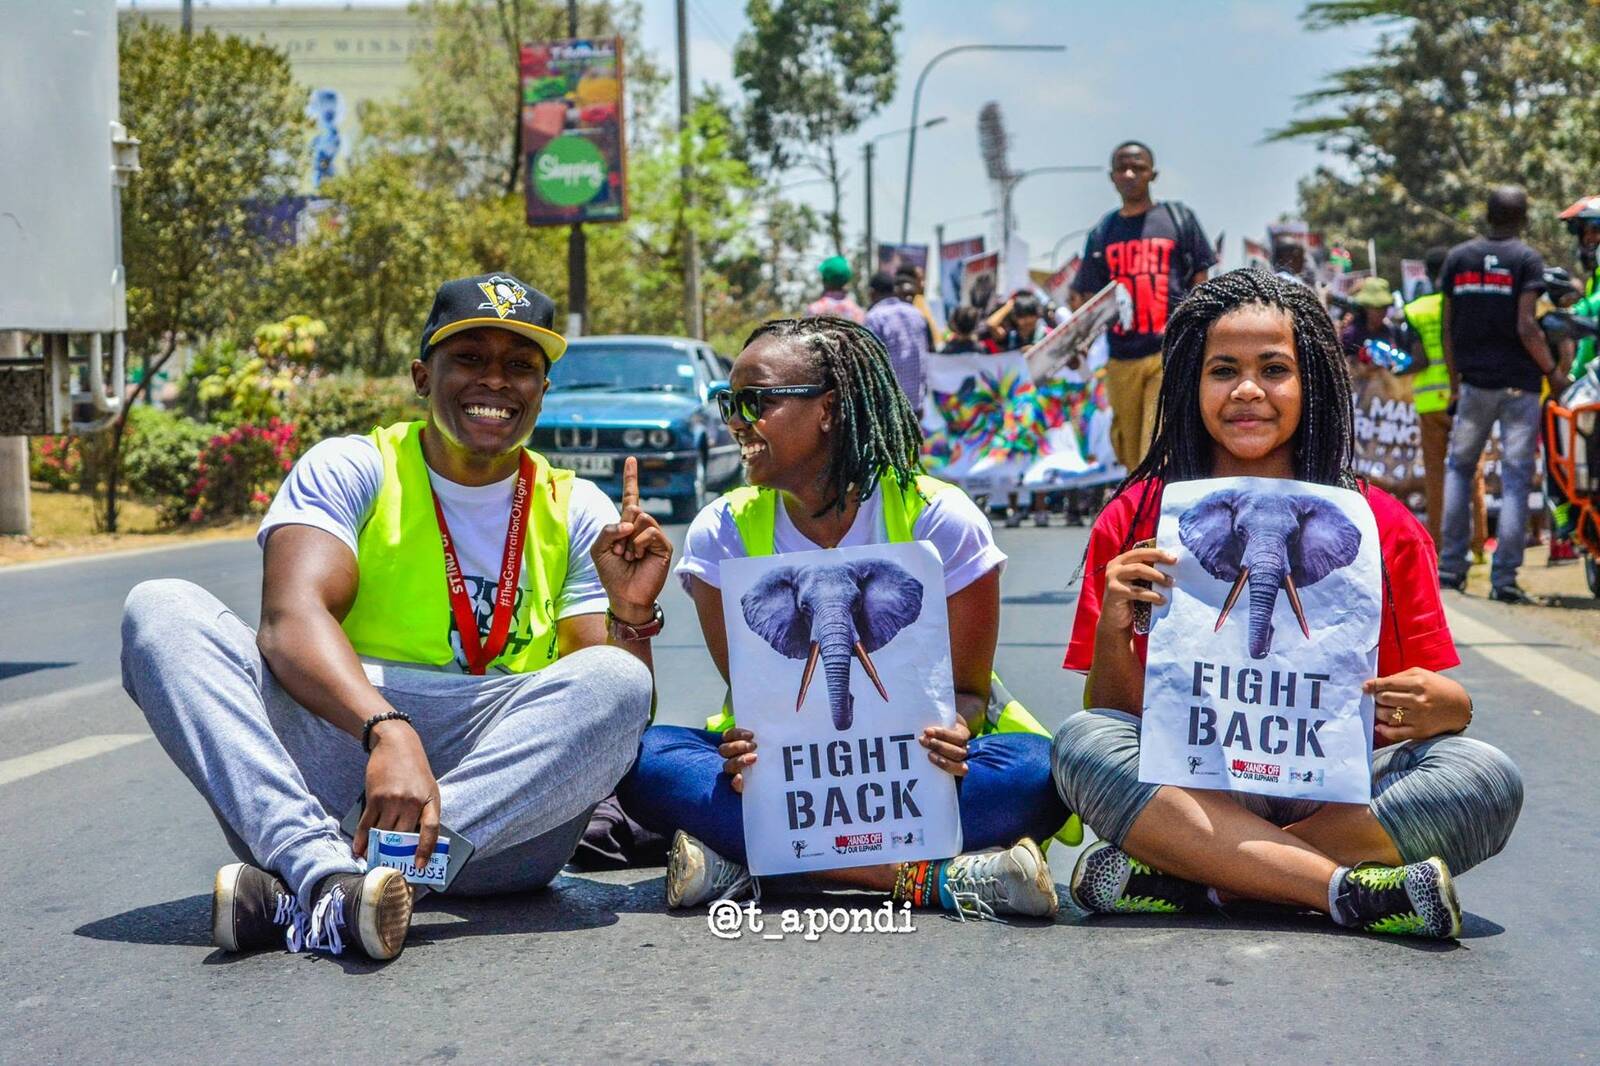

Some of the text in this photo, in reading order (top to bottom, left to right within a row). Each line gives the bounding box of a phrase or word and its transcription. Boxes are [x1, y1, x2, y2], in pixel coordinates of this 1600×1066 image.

[538, 154, 605, 189] Shopping
[1105, 237, 1175, 279] FIGHT
[499, 477, 528, 608] #TheGenerationOfLight
[1191, 661, 1330, 709] FIGHT
[1188, 706, 1326, 758] BACK
[782, 733, 915, 782] FIGHT
[1243, 772, 1279, 783] OUR ELEPHANTS
[1244, 762, 1266, 773] HANDS
[1267, 765, 1280, 776] OFF
[786, 778, 922, 830] BACK
[848, 835, 870, 846] HANDS
[870, 833, 882, 843] OFF
[859, 844, 882, 853] ELEPHANTS
